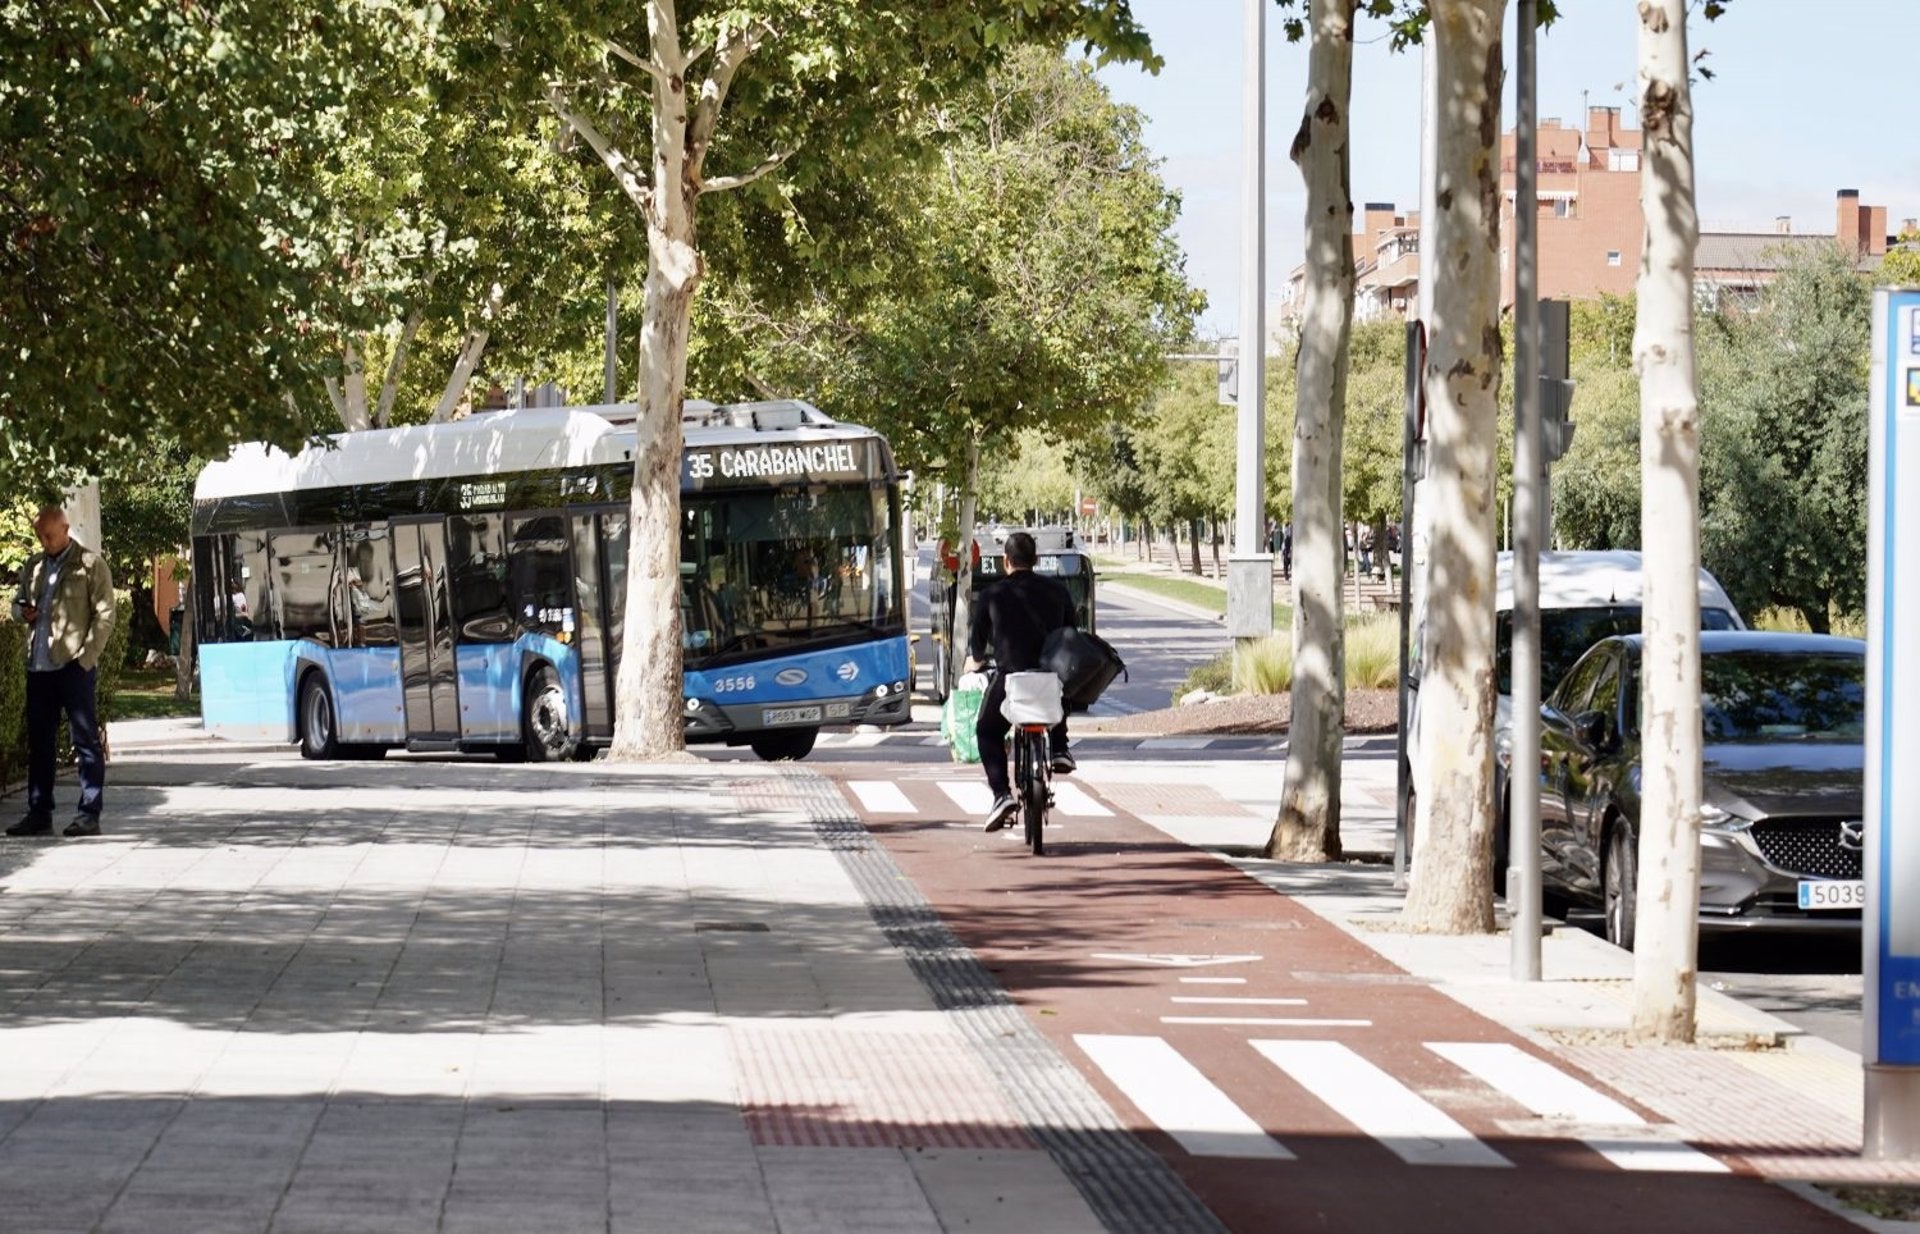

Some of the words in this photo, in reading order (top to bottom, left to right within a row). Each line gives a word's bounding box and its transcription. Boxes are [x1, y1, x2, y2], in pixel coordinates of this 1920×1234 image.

[688, 454, 713, 478] 35
[720, 445, 857, 478] CARABANCHEL
[715, 676, 756, 693] 3556
[1815, 885, 1865, 904] 5039
